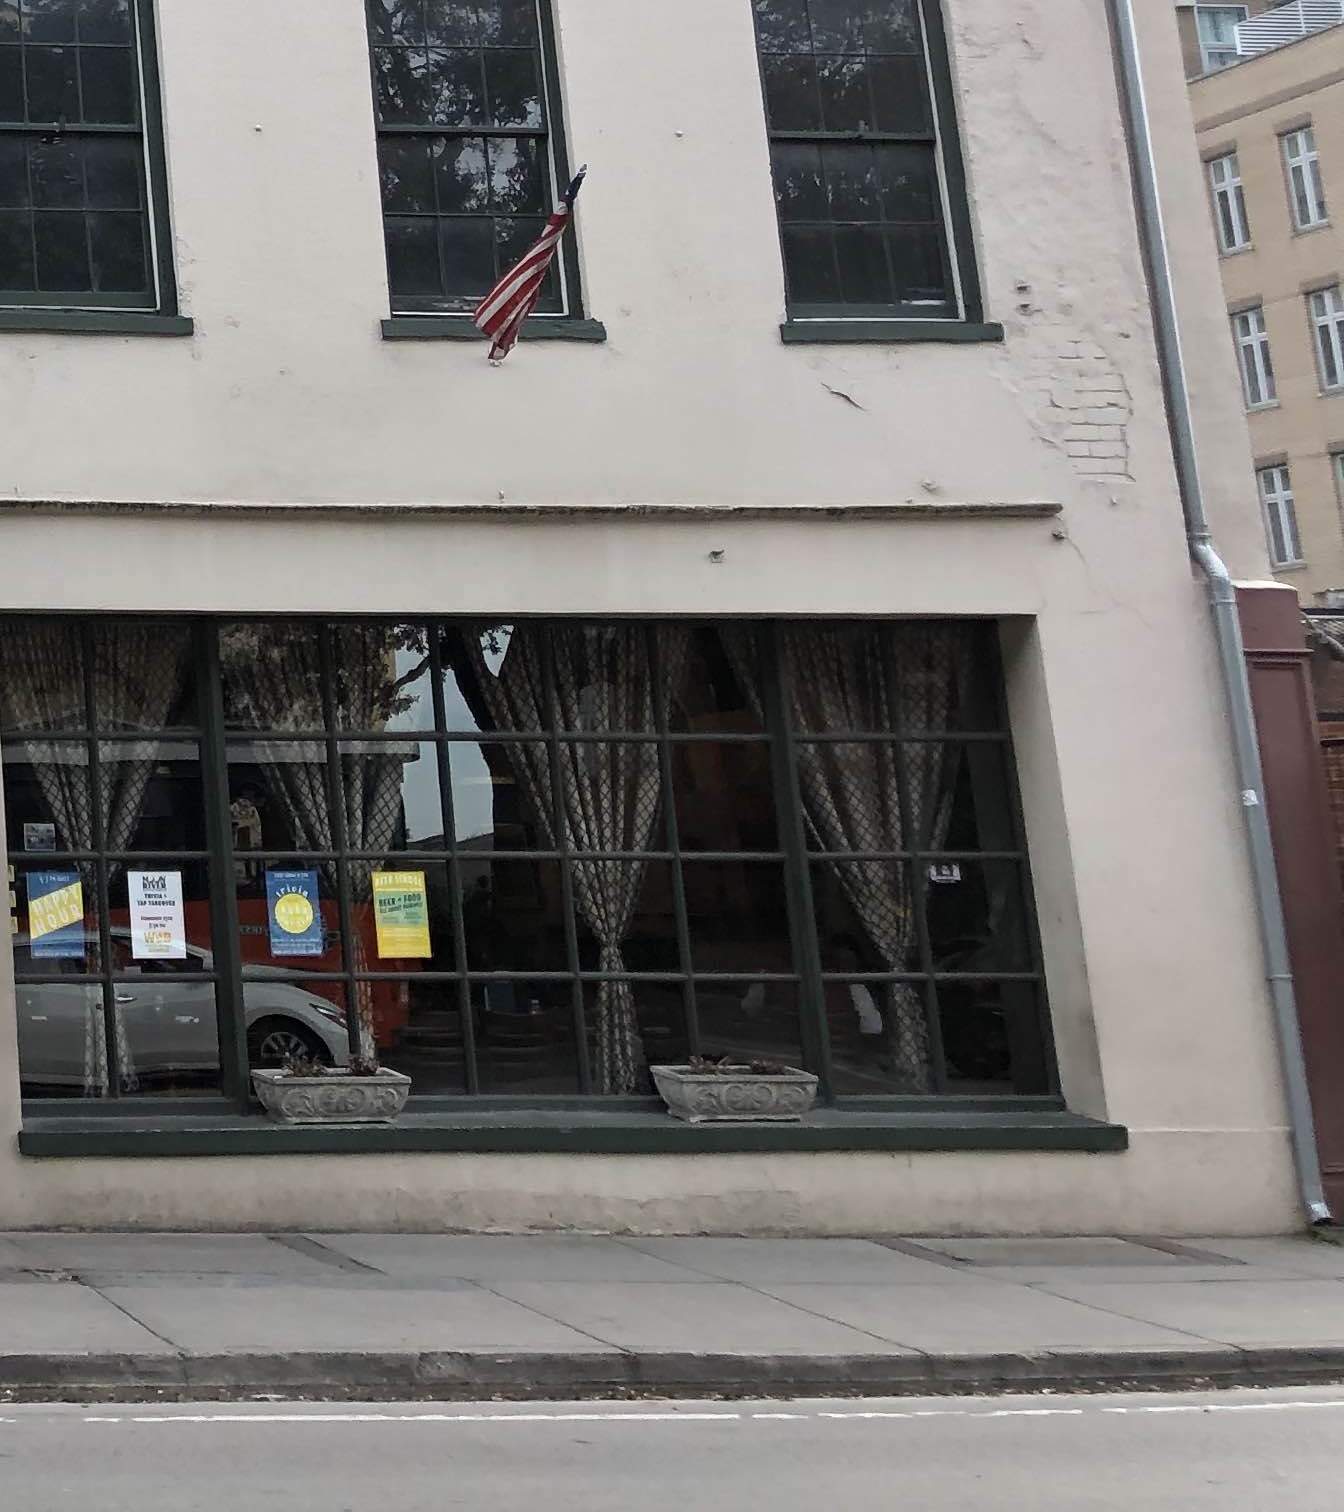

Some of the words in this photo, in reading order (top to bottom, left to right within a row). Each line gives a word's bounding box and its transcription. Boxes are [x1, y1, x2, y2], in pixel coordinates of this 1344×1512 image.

[33, 886, 81, 916] HAPPY
[403, 893, 422, 903] FOOD
[33, 903, 82, 934] HOUR
